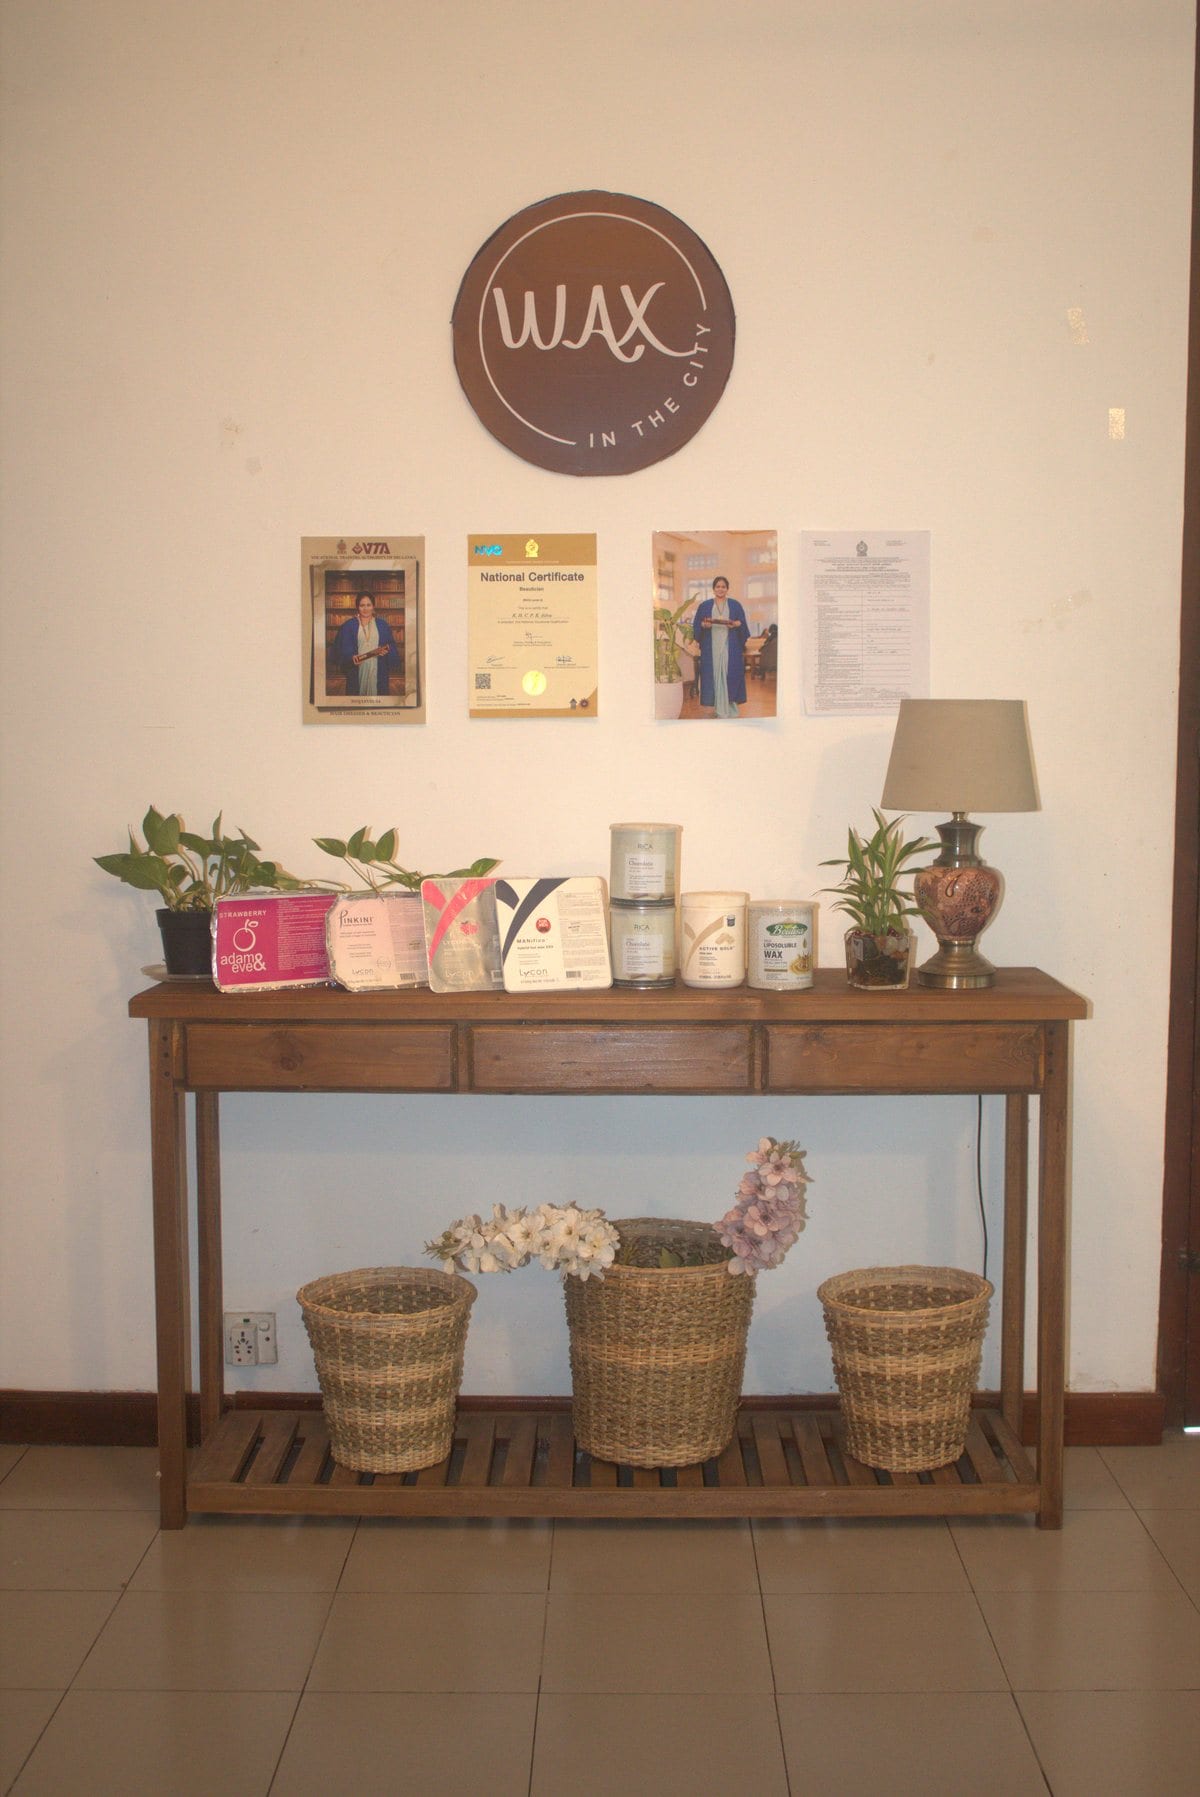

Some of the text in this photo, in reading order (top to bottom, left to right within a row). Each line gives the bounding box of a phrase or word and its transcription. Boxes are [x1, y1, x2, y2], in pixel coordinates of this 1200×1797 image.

[493, 282, 696, 362] WAX
[589, 323, 711, 448] IN THE CITY
[362, 542, 391, 554] VTA
[480, 572, 585, 581] National Certificate
[218, 910, 267, 918] STRAWBERRY
[220, 953, 255, 965] adam
[763, 950, 783, 958] WAX
[231, 963, 254, 973] eve
